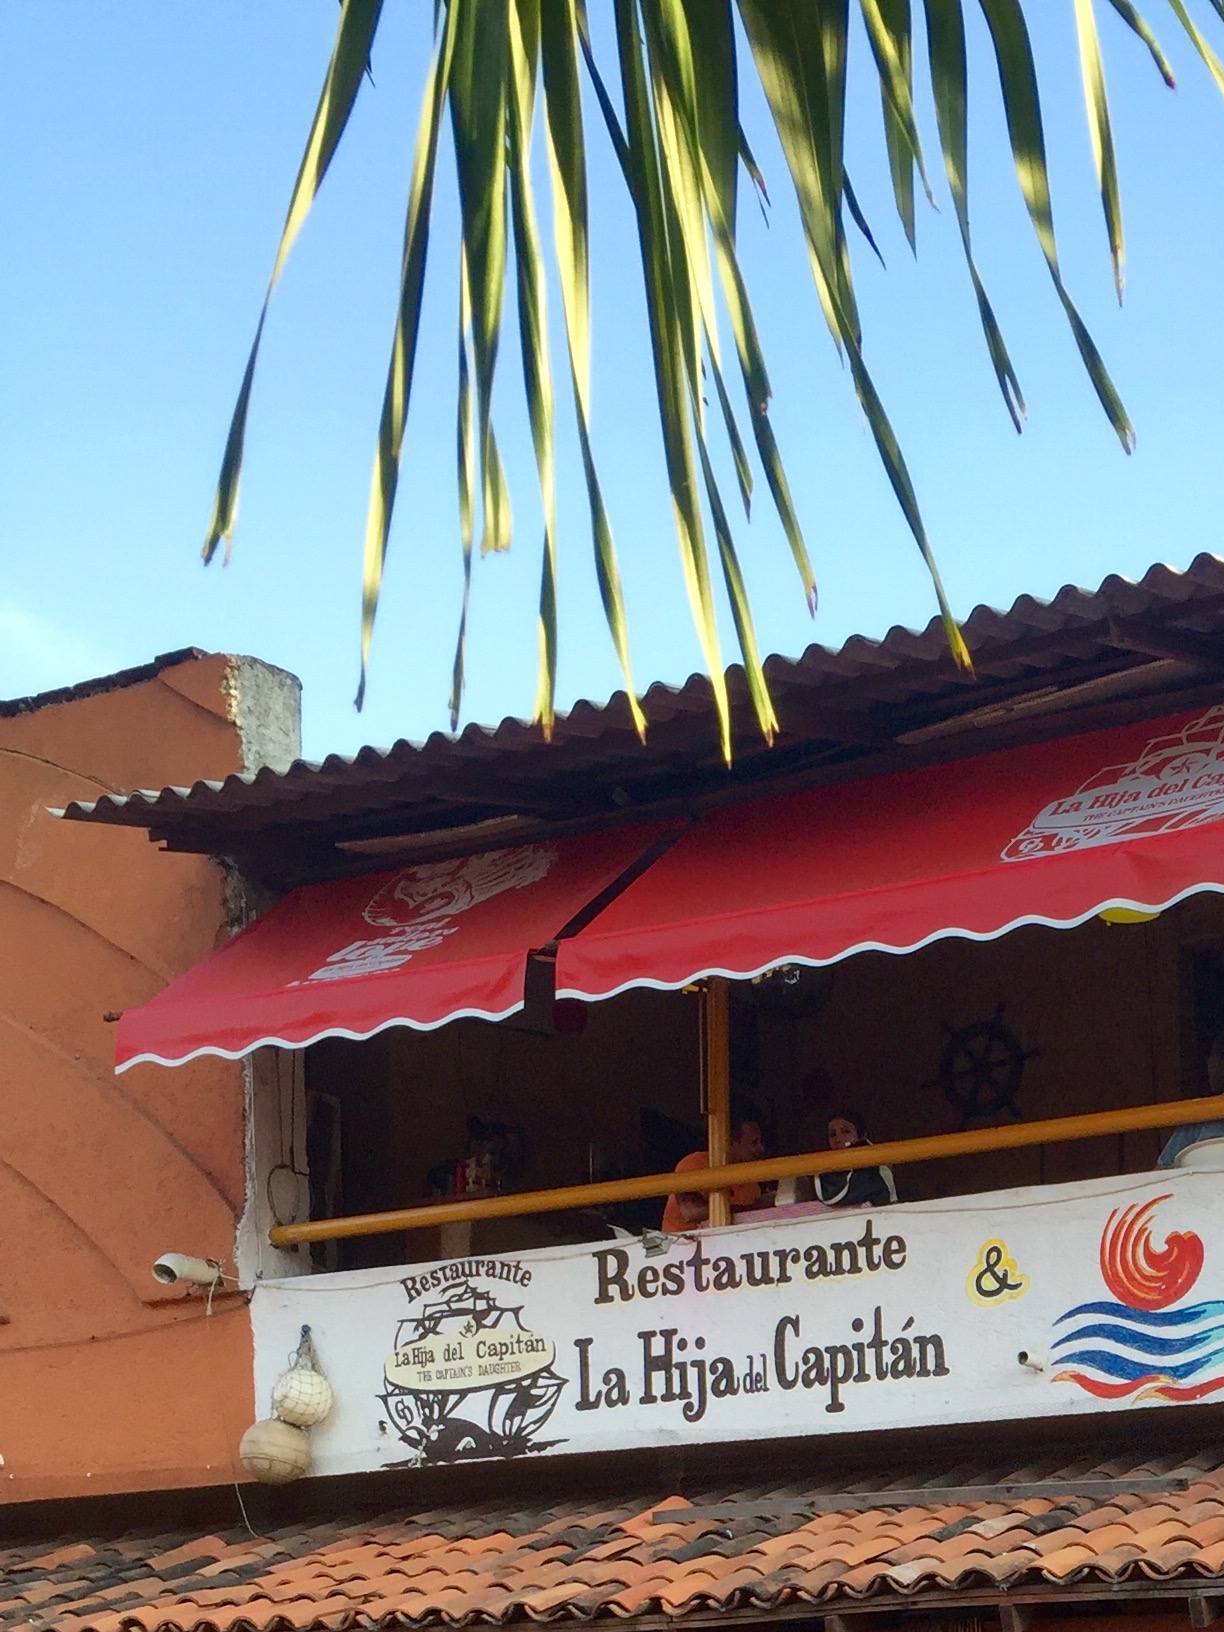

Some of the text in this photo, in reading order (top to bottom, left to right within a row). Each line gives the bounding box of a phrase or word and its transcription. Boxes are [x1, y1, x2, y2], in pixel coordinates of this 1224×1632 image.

[1049, 800, 1081, 817] La
[1088, 788, 1140, 811] Hija
[1147, 779, 1188, 797] del
[400, 1259, 533, 1304] Restaurante
[592, 1218, 1023, 1305] Restaurante &
[394, 1332, 547, 1369] La Hija del Capitán
[573, 1305, 951, 1423] La Hija del Capitán
[417, 1370, 433, 1383] THE
[478, 1361, 522, 1377] DAUGHTER
